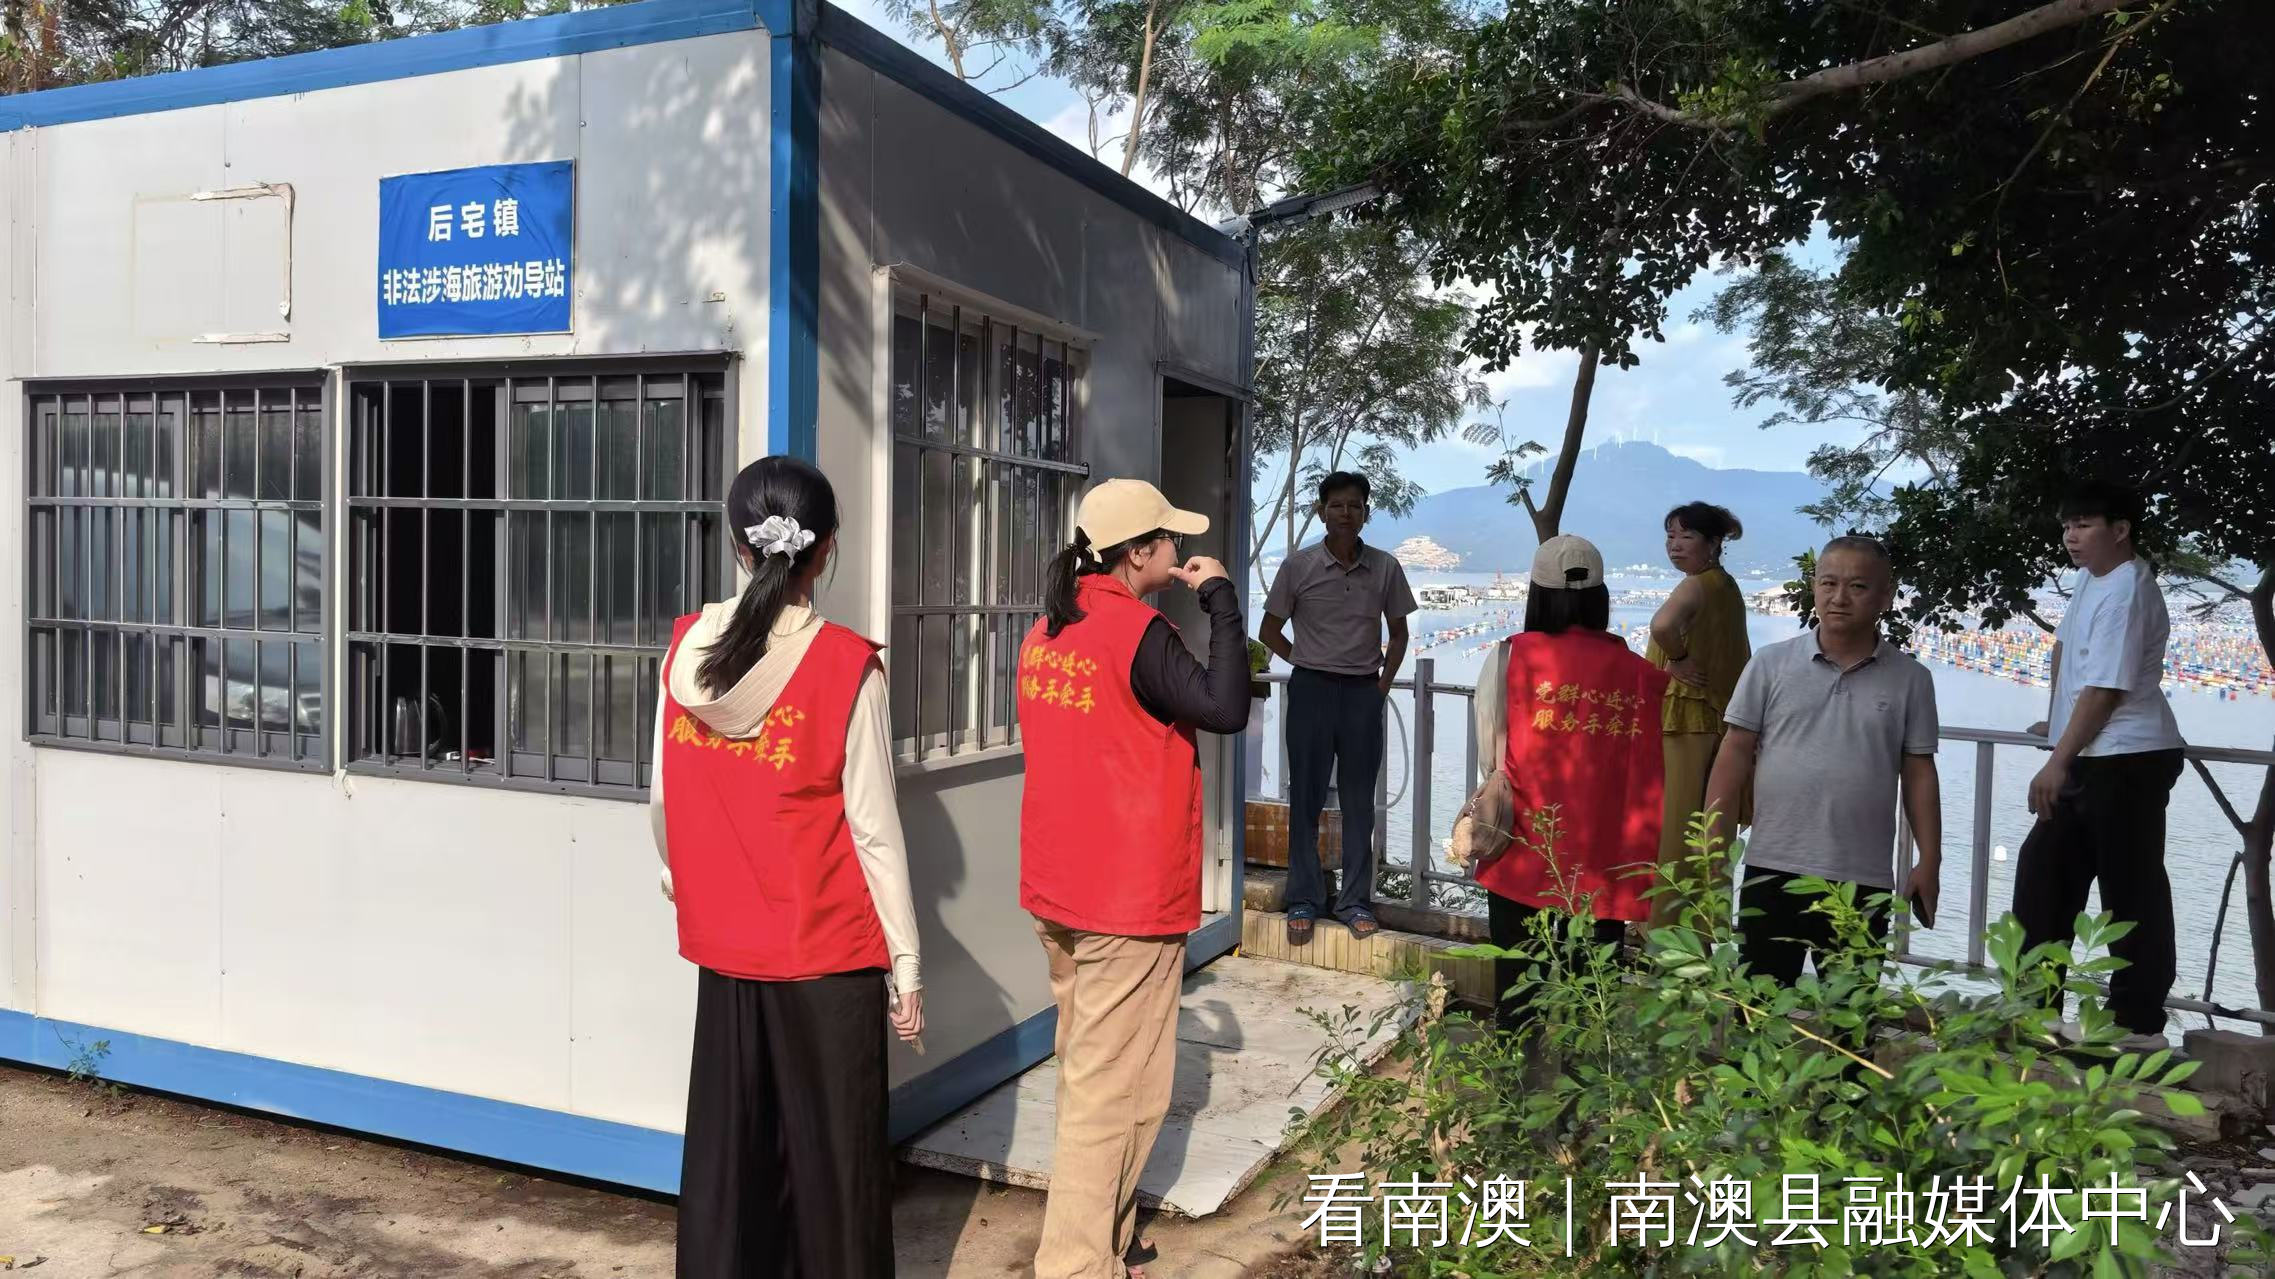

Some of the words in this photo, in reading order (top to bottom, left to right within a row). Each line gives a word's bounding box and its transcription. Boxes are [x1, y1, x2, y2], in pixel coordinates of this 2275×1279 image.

[427, 198, 520, 242] 后宅镇
[383, 258, 565, 306] 非法涉海旅游劝导站
[1535, 680, 1646, 709] 党群心连心
[1531, 709, 1643, 737] 服务手牵手
